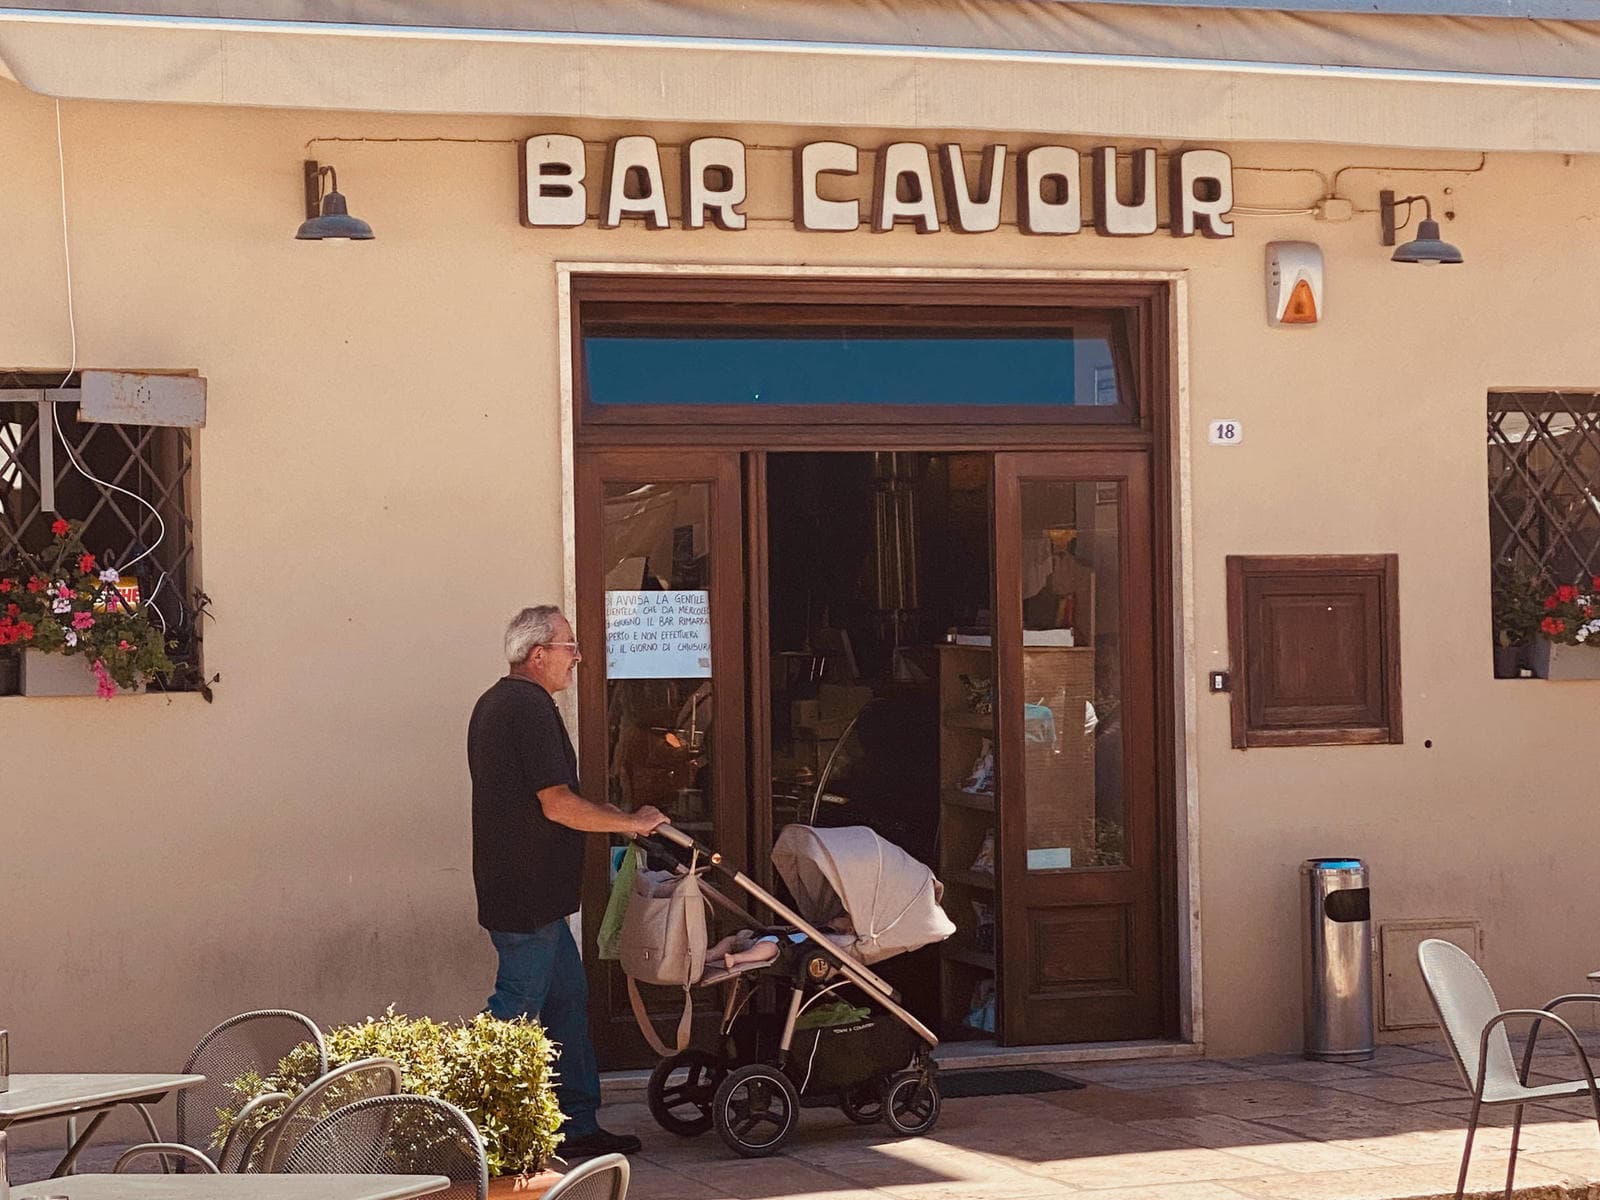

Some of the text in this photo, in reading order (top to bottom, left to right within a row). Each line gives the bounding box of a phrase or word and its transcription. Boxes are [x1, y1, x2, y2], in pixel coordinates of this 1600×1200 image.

[519, 132, 1235, 240] BAR CAVOUR
[1216, 423, 1235, 439] 18
[616, 595, 650, 606] AVVISA
[656, 594, 669, 605] LA
[674, 593, 704, 604] GENTILE
[642, 606, 657, 615] CHE
[662, 606, 674, 615] DA
[613, 616, 641, 627] GIUGNO
[647, 617, 655, 627] IL
[659, 616, 674, 627] BAR
[606, 631, 629, 641] PERTO
[634, 631, 638, 640] E
[640, 631, 657, 641] NON
[619, 644, 627, 654] IL
[629, 643, 658, 653] GIORNO
[662, 643, 671, 652] DI
